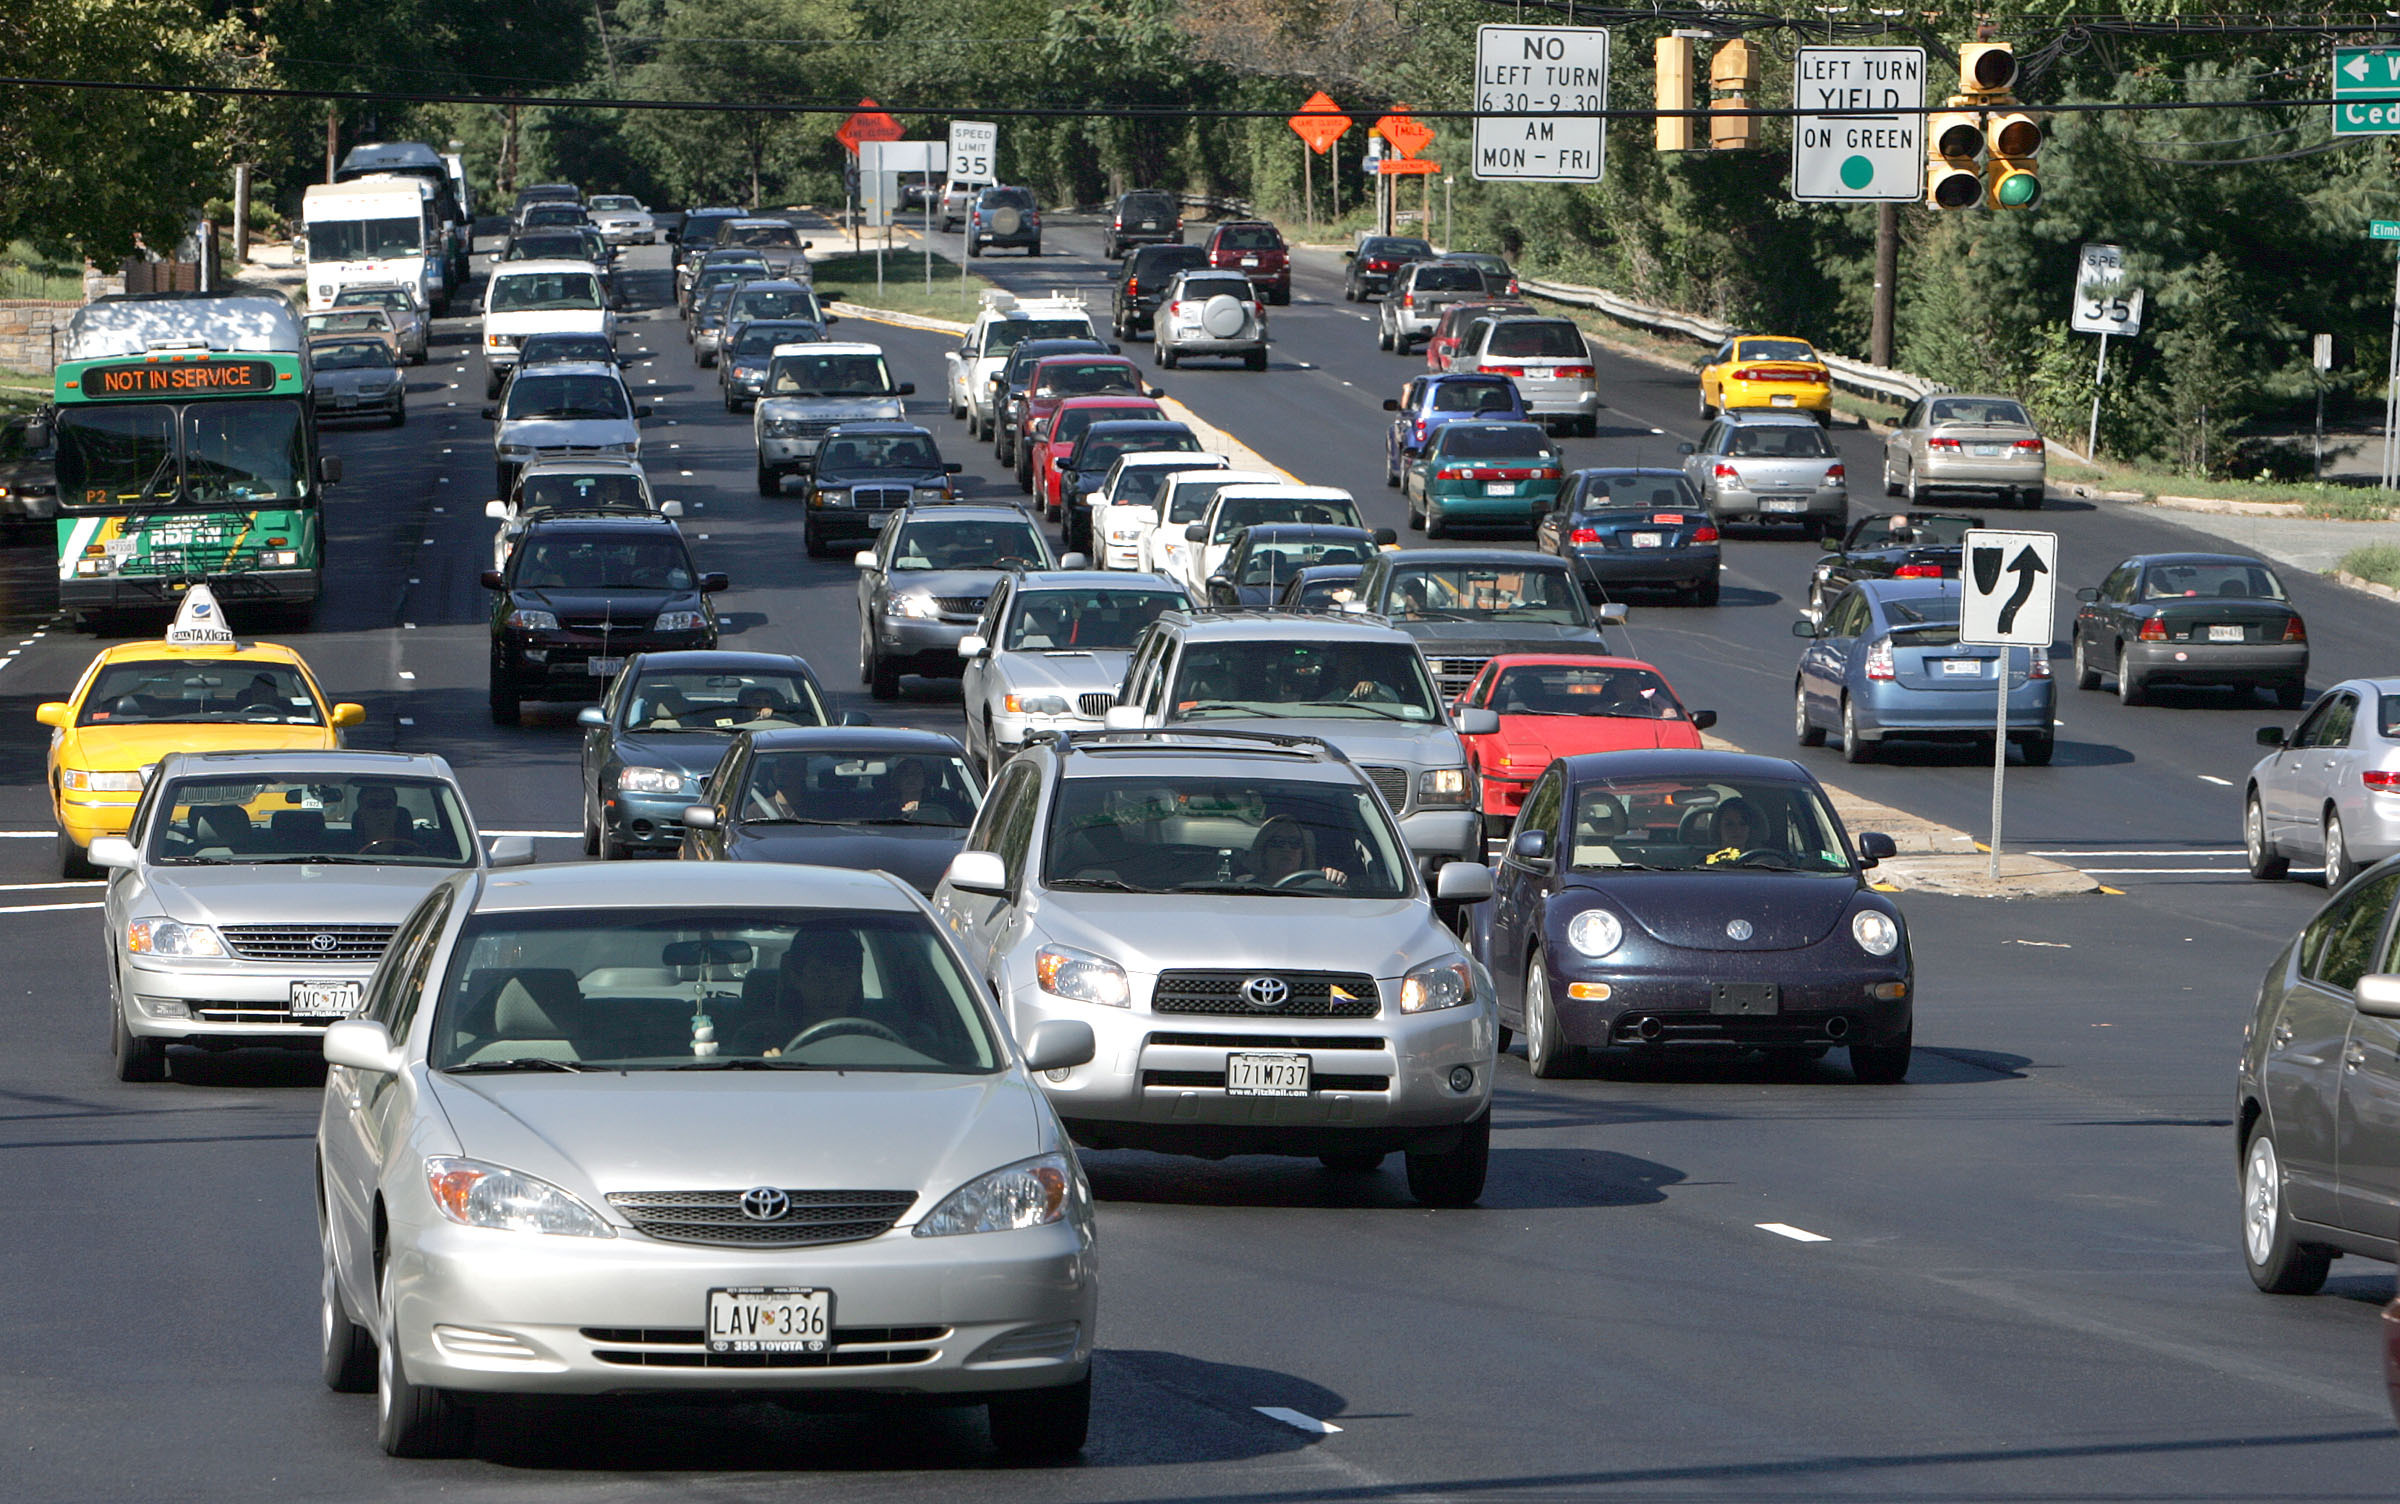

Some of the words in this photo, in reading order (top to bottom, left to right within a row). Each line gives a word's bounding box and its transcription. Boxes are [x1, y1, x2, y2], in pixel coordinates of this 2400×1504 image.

[1524, 37, 1564, 60] NO
[1484, 65, 1532, 86] LEFT
[1546, 66, 1599, 87] TURN
[1804, 61, 1850, 80] LEFT
[1864, 61, 1917, 81] TURN
[955, 129, 992, 139] SPEED
[1400, 126, 1425, 137] MILE
[1526, 122, 1553, 141] AM
[1804, 129, 1831, 148] ON
[1847, 129, 1912, 149] GREEN
[958, 143, 986, 152] LIMIT
[956, 157, 987, 175] 35
[1484, 148, 1525, 168] MON
[1559, 150, 1590, 169] FRI
[2087, 255, 2124, 270] SPE
[2084, 296, 2130, 323] 35
[104, 371, 144, 391] NOT
[150, 370, 169, 389] IN
[171, 366, 252, 388] SERVICE
[87, 490, 106, 503] P2
[190, 628, 215, 641] TAXI
[293, 991, 320, 1008] KVC
[330, 991, 355, 1008] 771
[1233, 1064, 1307, 1086] 171M737
[1228, 1088, 1308, 1097] www.FitzMall.com
[714, 1305, 758, 1335] LAV
[779, 1306, 824, 1335] 336
[734, 1341, 757, 1352] 355
[760, 1341, 804, 1352] TOYOTA
